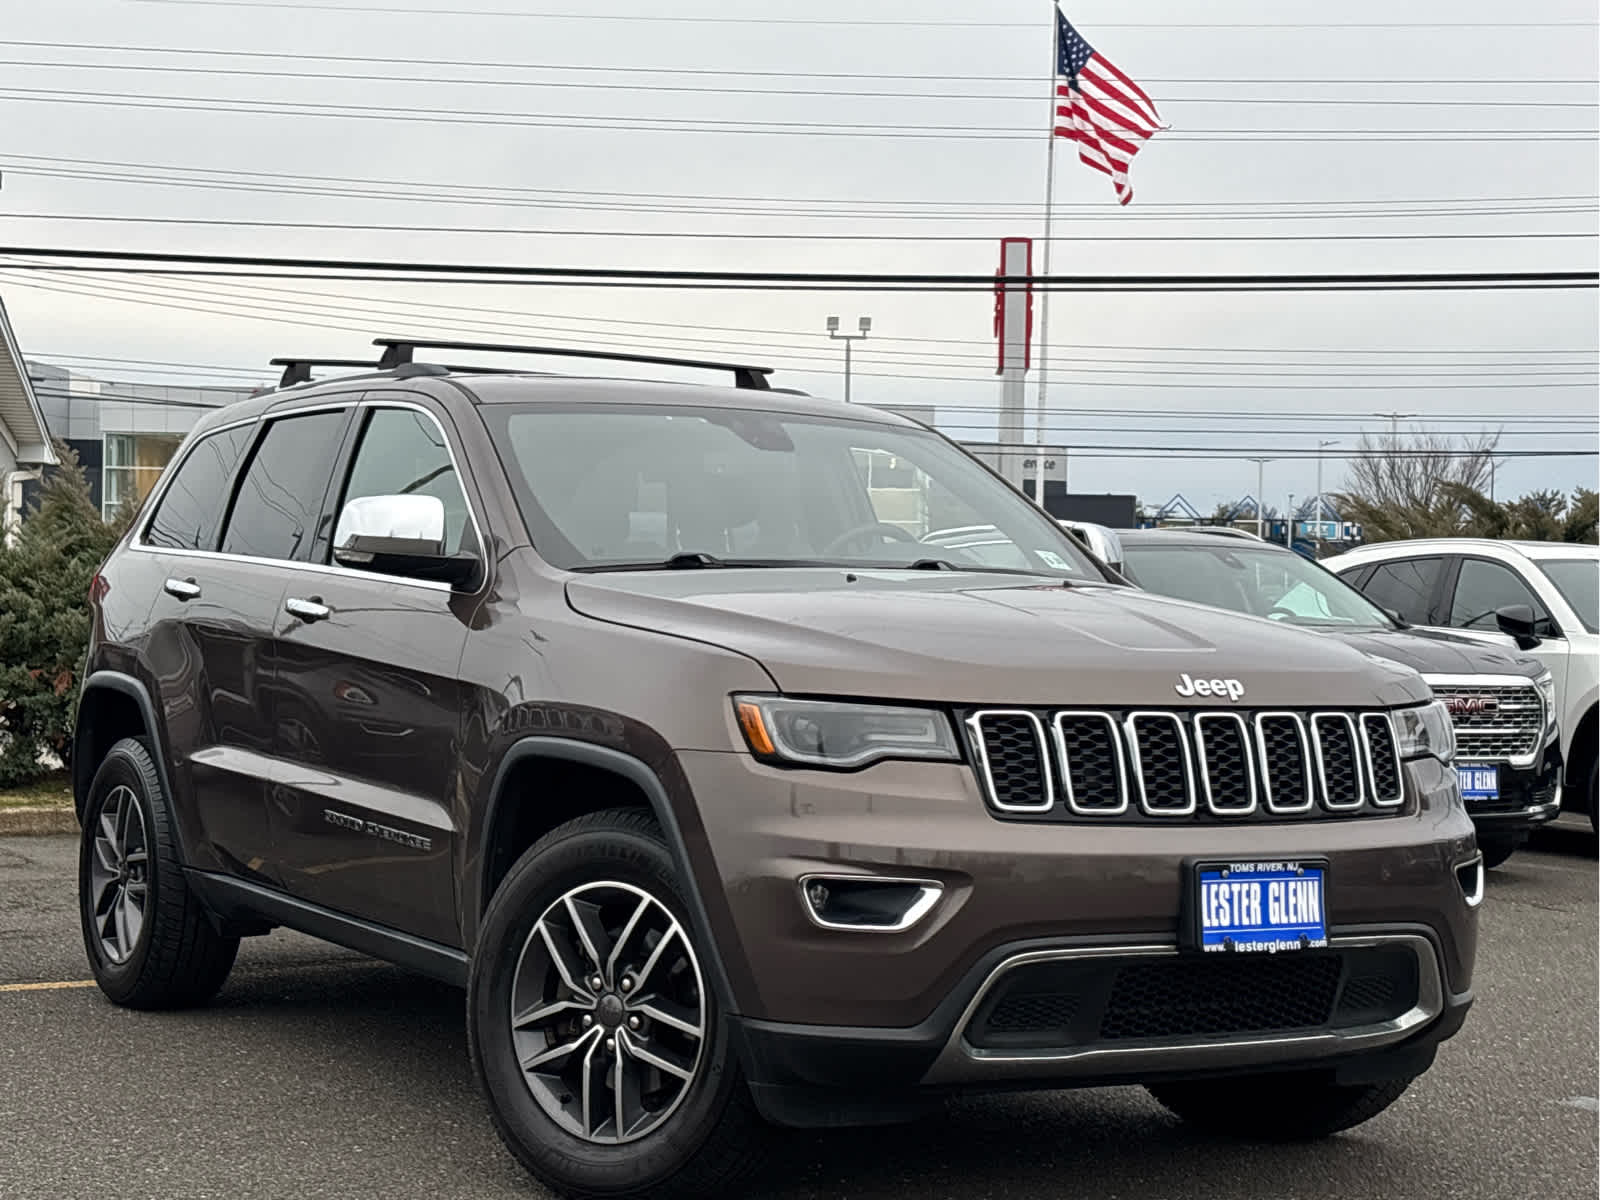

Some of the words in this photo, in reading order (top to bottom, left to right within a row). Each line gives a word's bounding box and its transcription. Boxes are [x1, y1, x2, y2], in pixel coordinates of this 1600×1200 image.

[1175, 673, 1245, 701] Jeep
[1229, 863, 1255, 873] TOMS
[1286, 862, 1299, 872] NJ
[1201, 882, 1262, 928] LESTER
[1268, 880, 1321, 925] GLENN
[1234, 938, 1301, 954] lesterglenn
